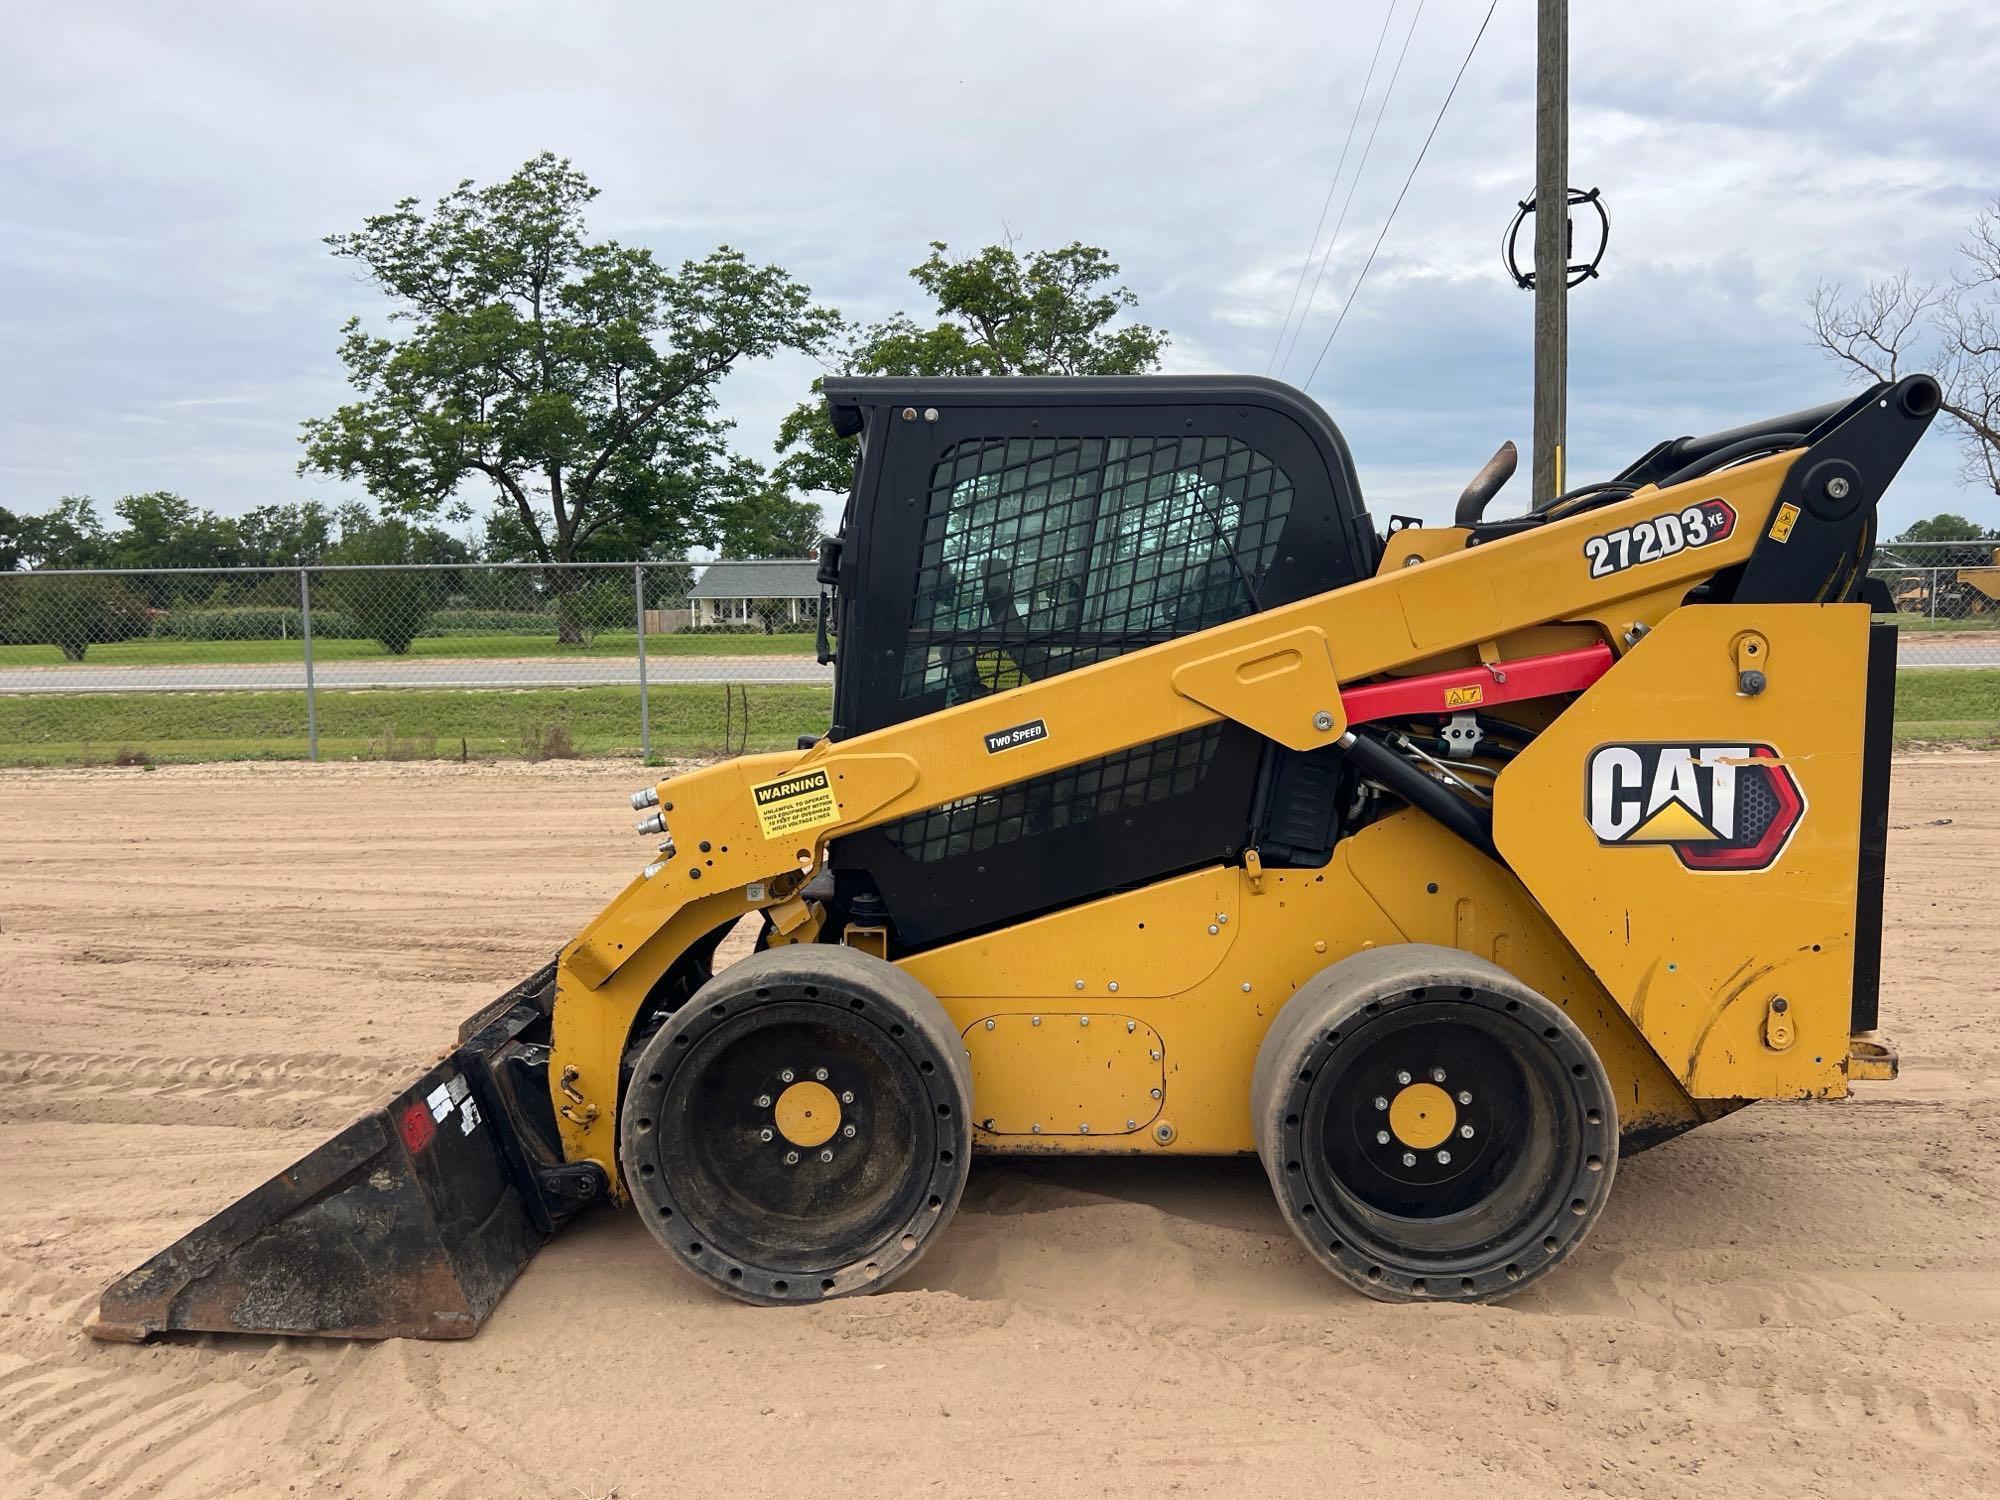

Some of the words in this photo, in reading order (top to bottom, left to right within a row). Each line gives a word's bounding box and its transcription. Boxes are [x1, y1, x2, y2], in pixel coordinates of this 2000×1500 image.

[1586, 508, 1708, 576] 272D3
[1707, 512, 1725, 528] XE
[989, 735, 1011, 748] TWO
[1012, 726, 1042, 742] SPEED
[758, 775, 825, 801] WARNING
[1592, 747, 1750, 841] CAT
[763, 804, 794, 815] UNLAWFUL
[795, 801, 804, 809] TO
[804, 794, 830, 805] OPERATE
[764, 813, 777, 821] THIS
[778, 805, 811, 818] EQUIPMENT
[812, 799, 833, 809] WITHIN
[801, 806, 831, 818] OVERHEAD
[772, 824, 787, 832] HIGH
[788, 817, 813, 827] VOLTAGE
